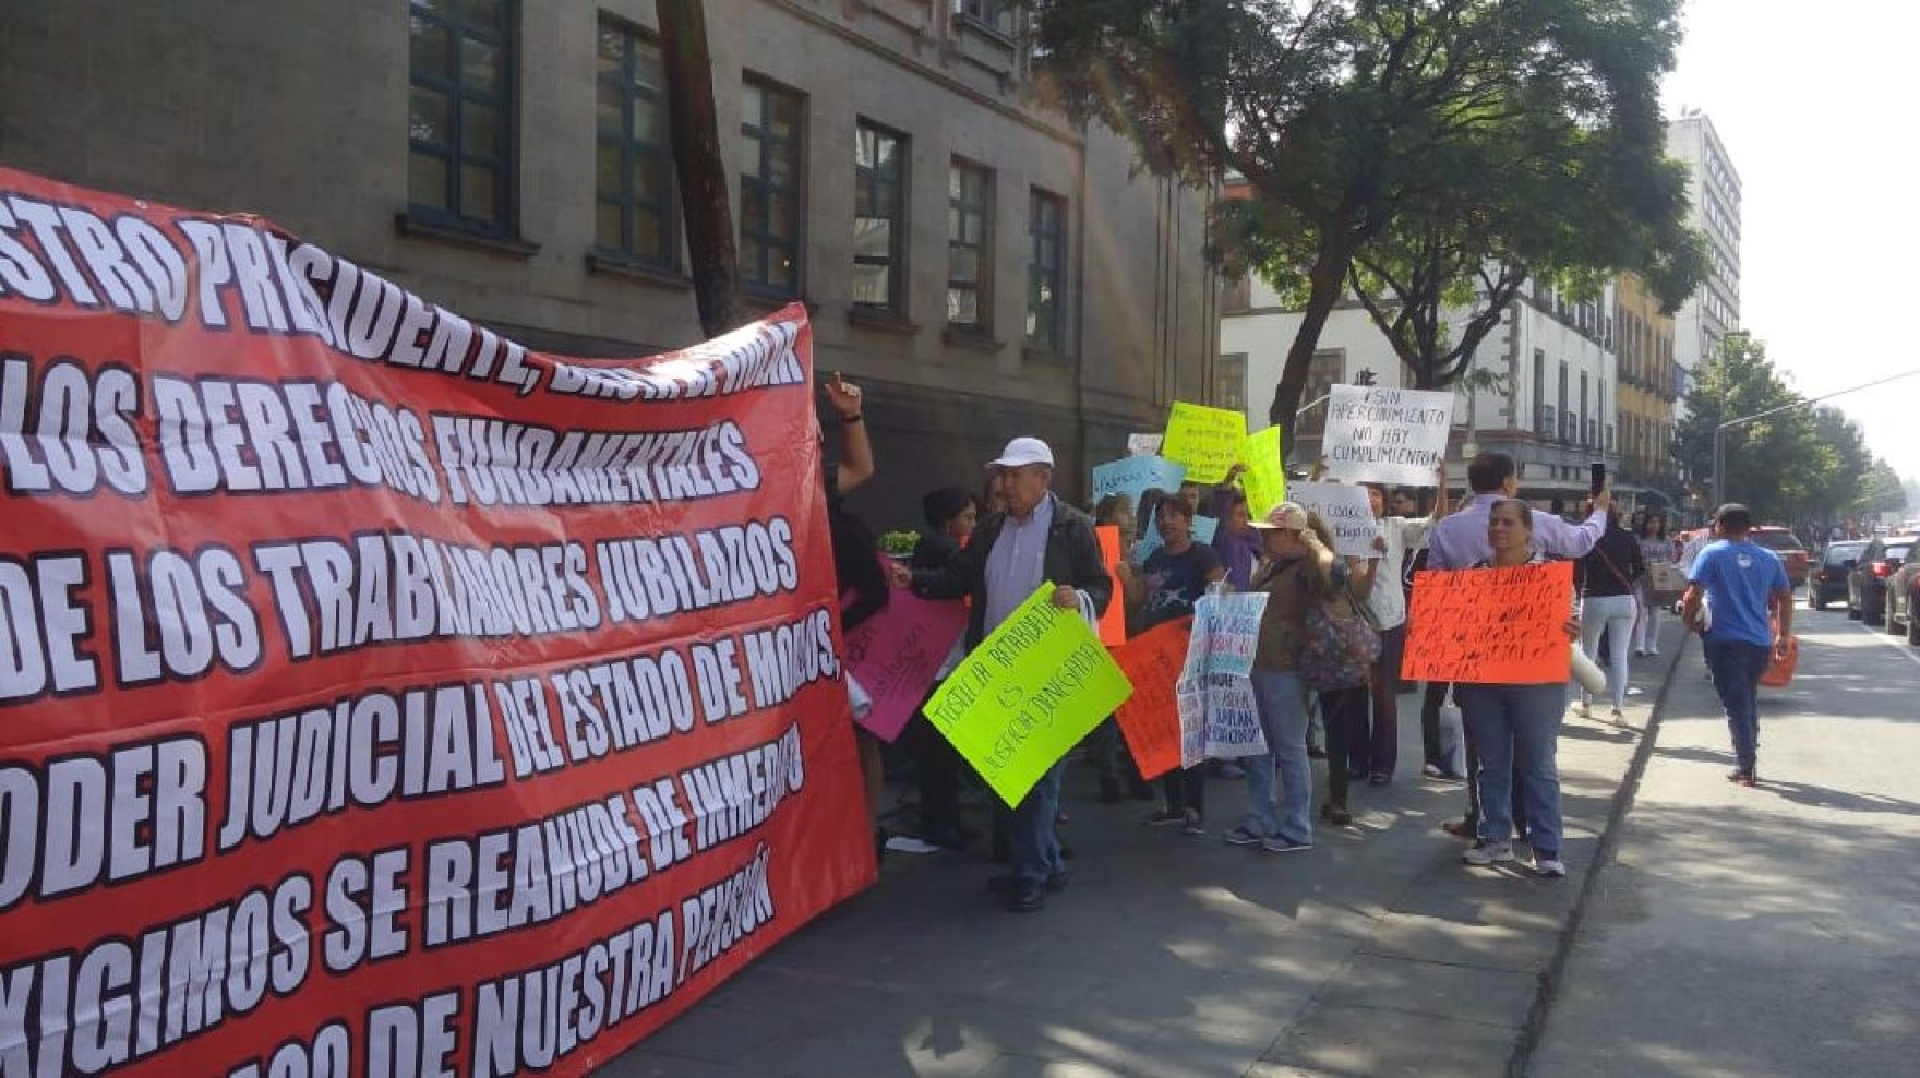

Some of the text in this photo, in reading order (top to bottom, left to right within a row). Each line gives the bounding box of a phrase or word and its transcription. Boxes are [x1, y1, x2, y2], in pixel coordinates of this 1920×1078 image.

[0, 195, 190, 323] STRO
[2, 357, 761, 506] LOS DERECHOS FUNDAMENTALES
[1352, 427, 1410, 445] NO HAY
[0, 555, 99, 700] DE
[107, 548, 262, 686] LOS
[598, 517, 798, 622] JUBILADOS
[0, 736, 208, 909] ODER
[219, 684, 506, 850] JUDICIAL
[493, 677, 565, 778] DEL
[551, 648, 696, 762] ESTADO
[691, 637, 748, 723] DE
[0, 873, 313, 1078] XIGIMOS
[324, 847, 410, 973] SE
[427, 795, 650, 947] REANUDE
[633, 780, 693, 871] DE
[368, 991, 460, 1078] DE
[474, 909, 674, 1078] NUESTRA
